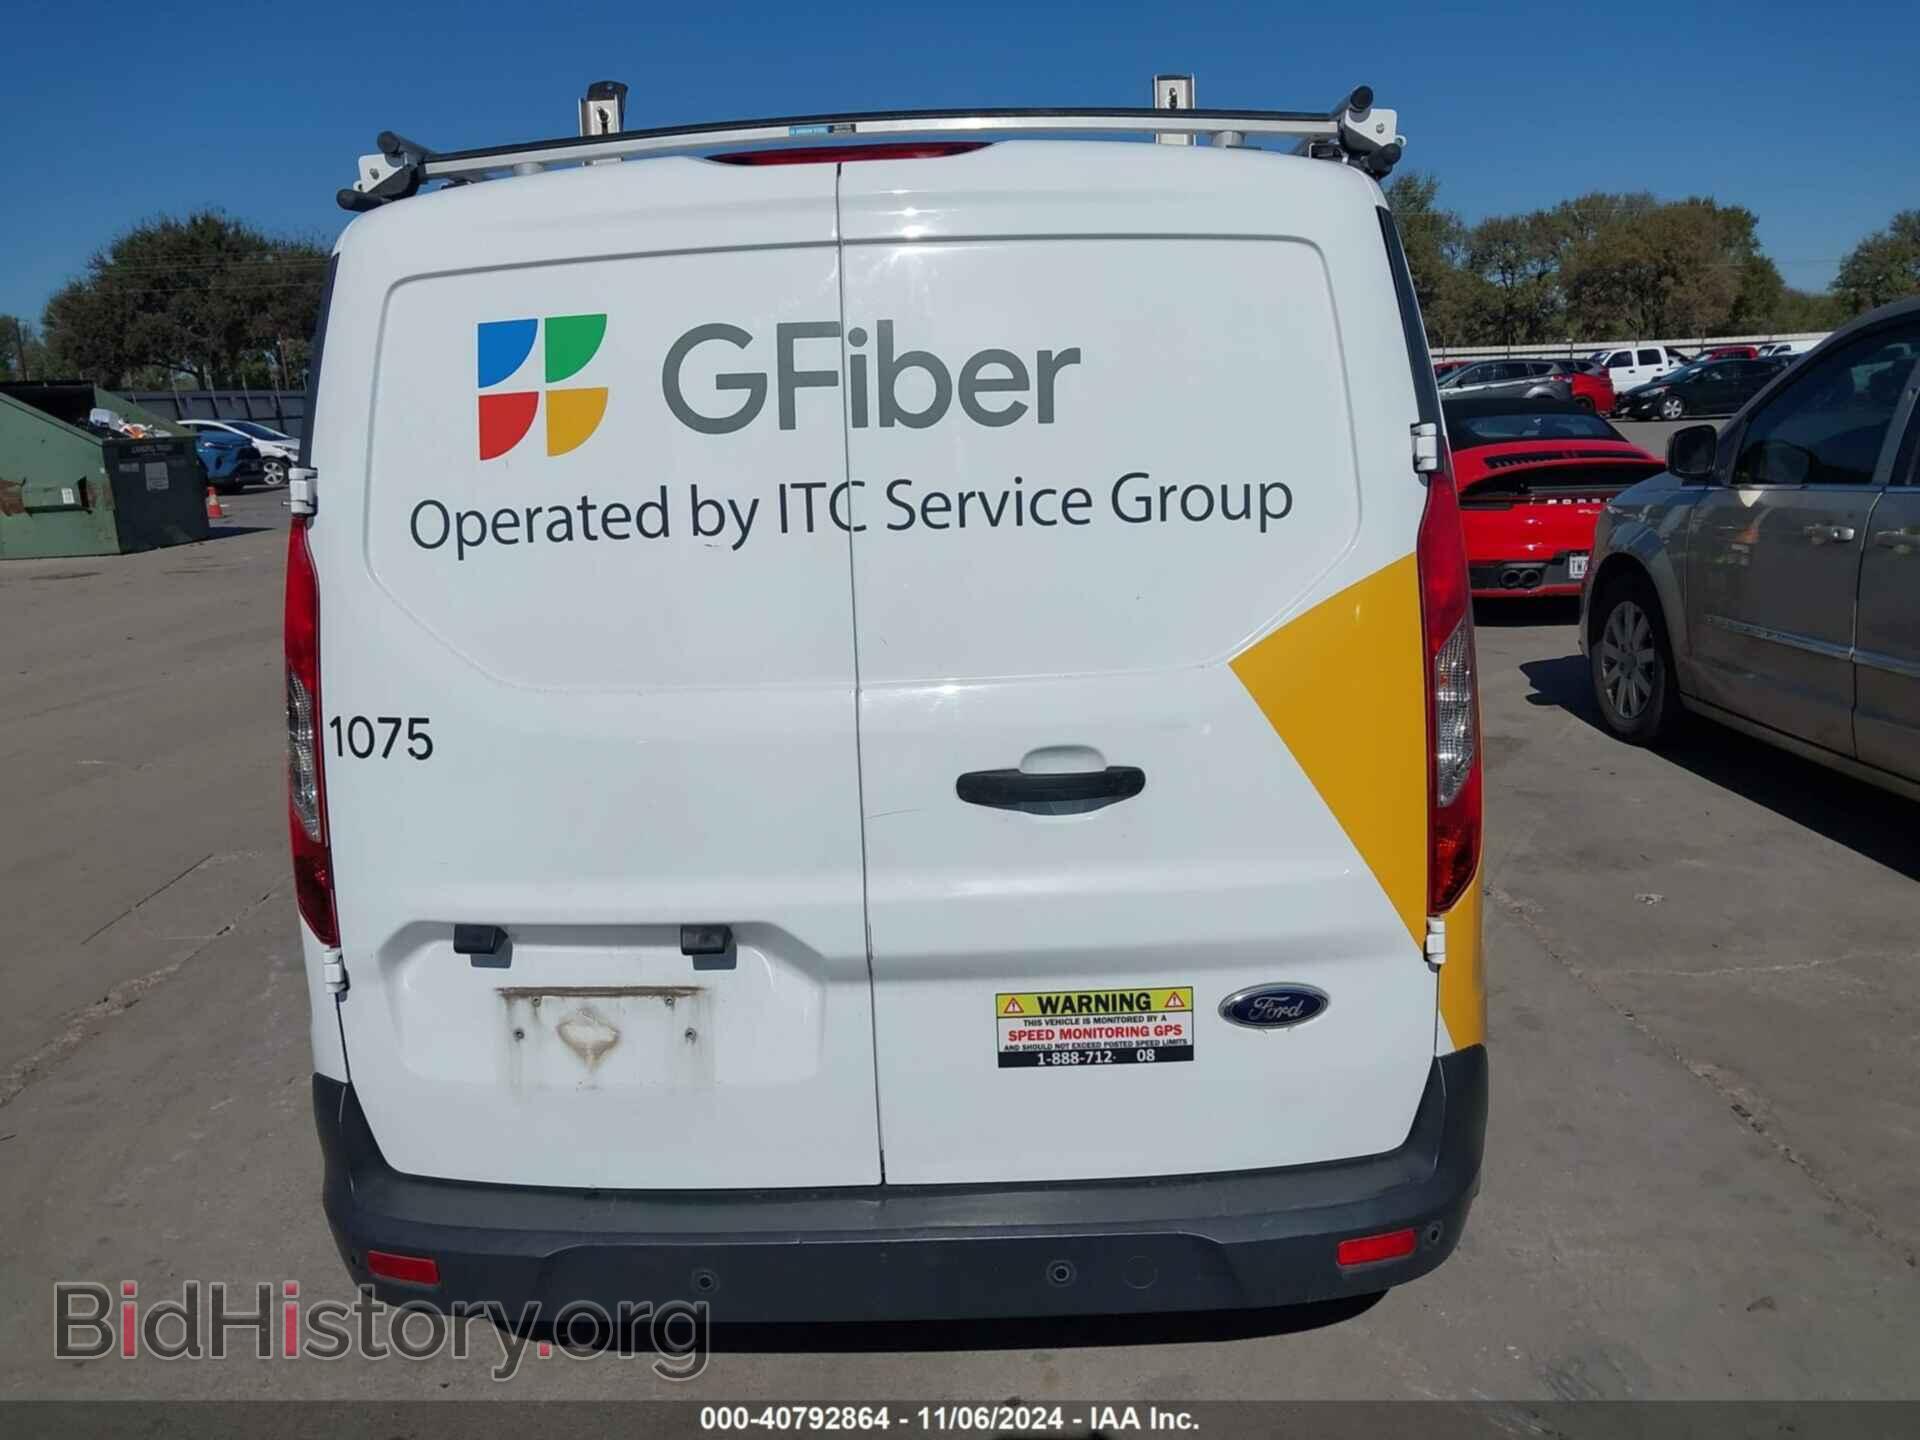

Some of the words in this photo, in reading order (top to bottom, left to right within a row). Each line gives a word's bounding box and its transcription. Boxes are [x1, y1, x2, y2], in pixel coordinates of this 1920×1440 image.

[662, 319, 1081, 436] GFiber
[410, 484, 670, 561] Operated
[690, 484, 760, 552] by
[779, 481, 867, 534] ITC
[885, 476, 1093, 531] Service
[1111, 472, 1293, 533] Group
[329, 715, 433, 760] 1075
[1037, 992, 1151, 1015] WARNING
[1248, 996, 1304, 1020] Ford
[1024, 1019, 1042, 1027] THIS
[1044, 1017, 1080, 1026] VEHICLE
[1082, 1017, 1091, 1025] IS
[1093, 1015, 1144, 1024] MONITORED
[1147, 1014, 1158, 1022] BY
[1161, 1014, 1167, 1022] A
[1008, 1029, 1055, 1042] SPEED
[1060, 1025, 1149, 1040] MONITORING
[1154, 1023, 1183, 1037] GPS
[1022, 1043, 1053, 1051] SHOULD
[1104, 1040, 1133, 1049] POSTED
[1135, 1039, 1160, 1048] SPEED
